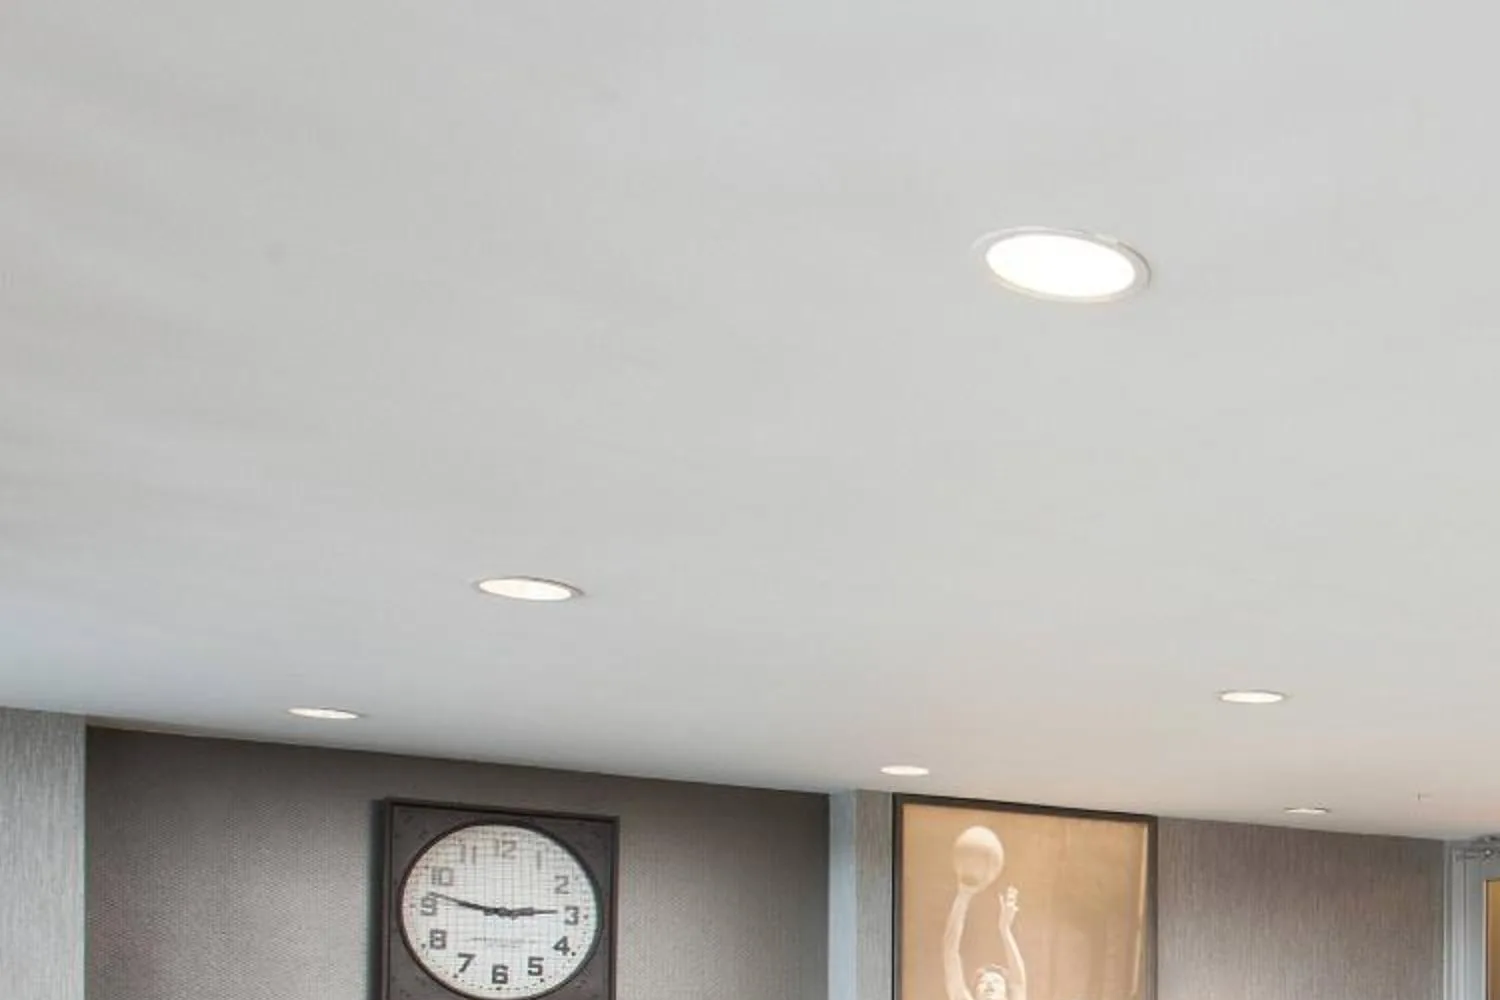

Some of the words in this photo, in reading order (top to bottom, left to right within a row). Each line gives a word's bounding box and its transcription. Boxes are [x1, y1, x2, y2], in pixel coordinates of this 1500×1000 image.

[460, 844, 477, 865] 11
[494, 839, 517, 860] 12
[431, 867, 454, 886] 10
[554, 874, 570, 895] 2
[420, 897, 437, 916] 9
[564, 906, 579, 926] 3
[429, 929, 447, 950] 8
[552, 936, 570, 957] 4
[458, 952, 476, 973] 7
[528, 957, 544, 976] 5
[491, 965, 509, 984] 6
